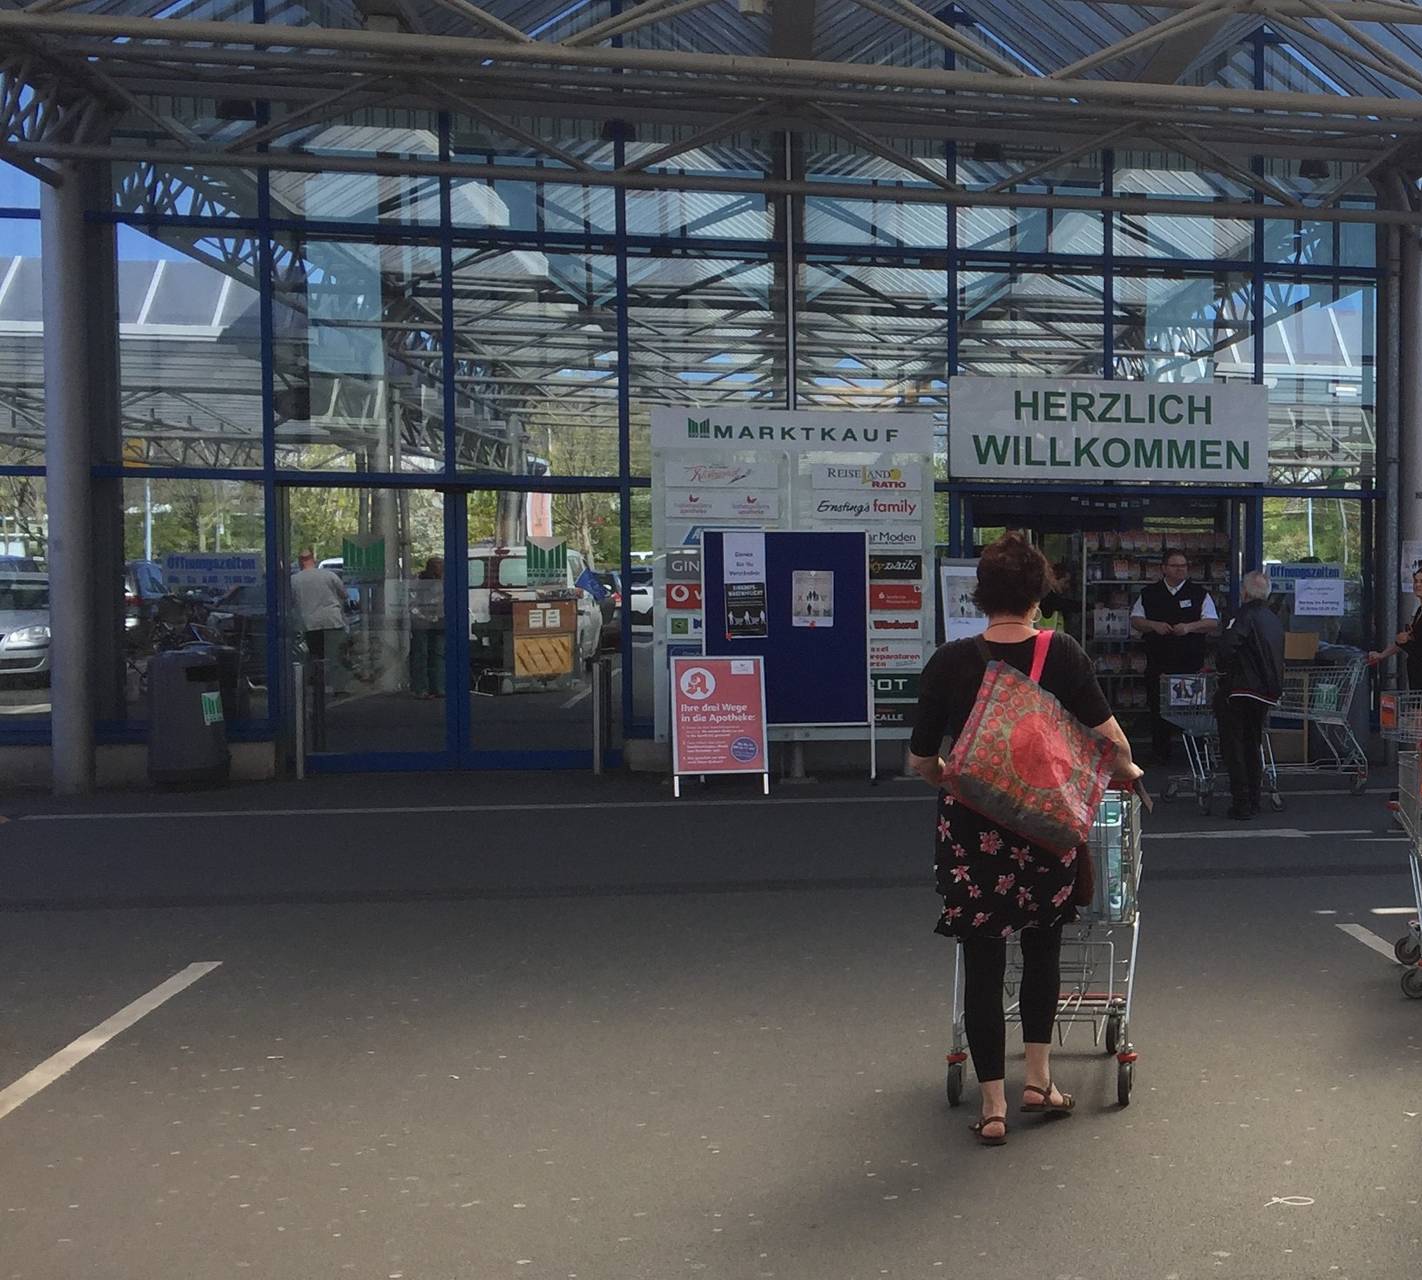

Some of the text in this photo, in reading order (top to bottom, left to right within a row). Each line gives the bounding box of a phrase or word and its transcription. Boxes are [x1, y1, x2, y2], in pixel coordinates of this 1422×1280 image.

[1014, 389, 1213, 425] HERZLICH
[713, 424, 900, 443] MARKTKAUF
[972, 433, 1251, 470] WILLKOMMEN
[871, 481, 907, 489] RATIO
[873, 498, 917, 515] family
[879, 532, 917, 542] Moden
[681, 703, 748, 713] Ihre drei Wege
